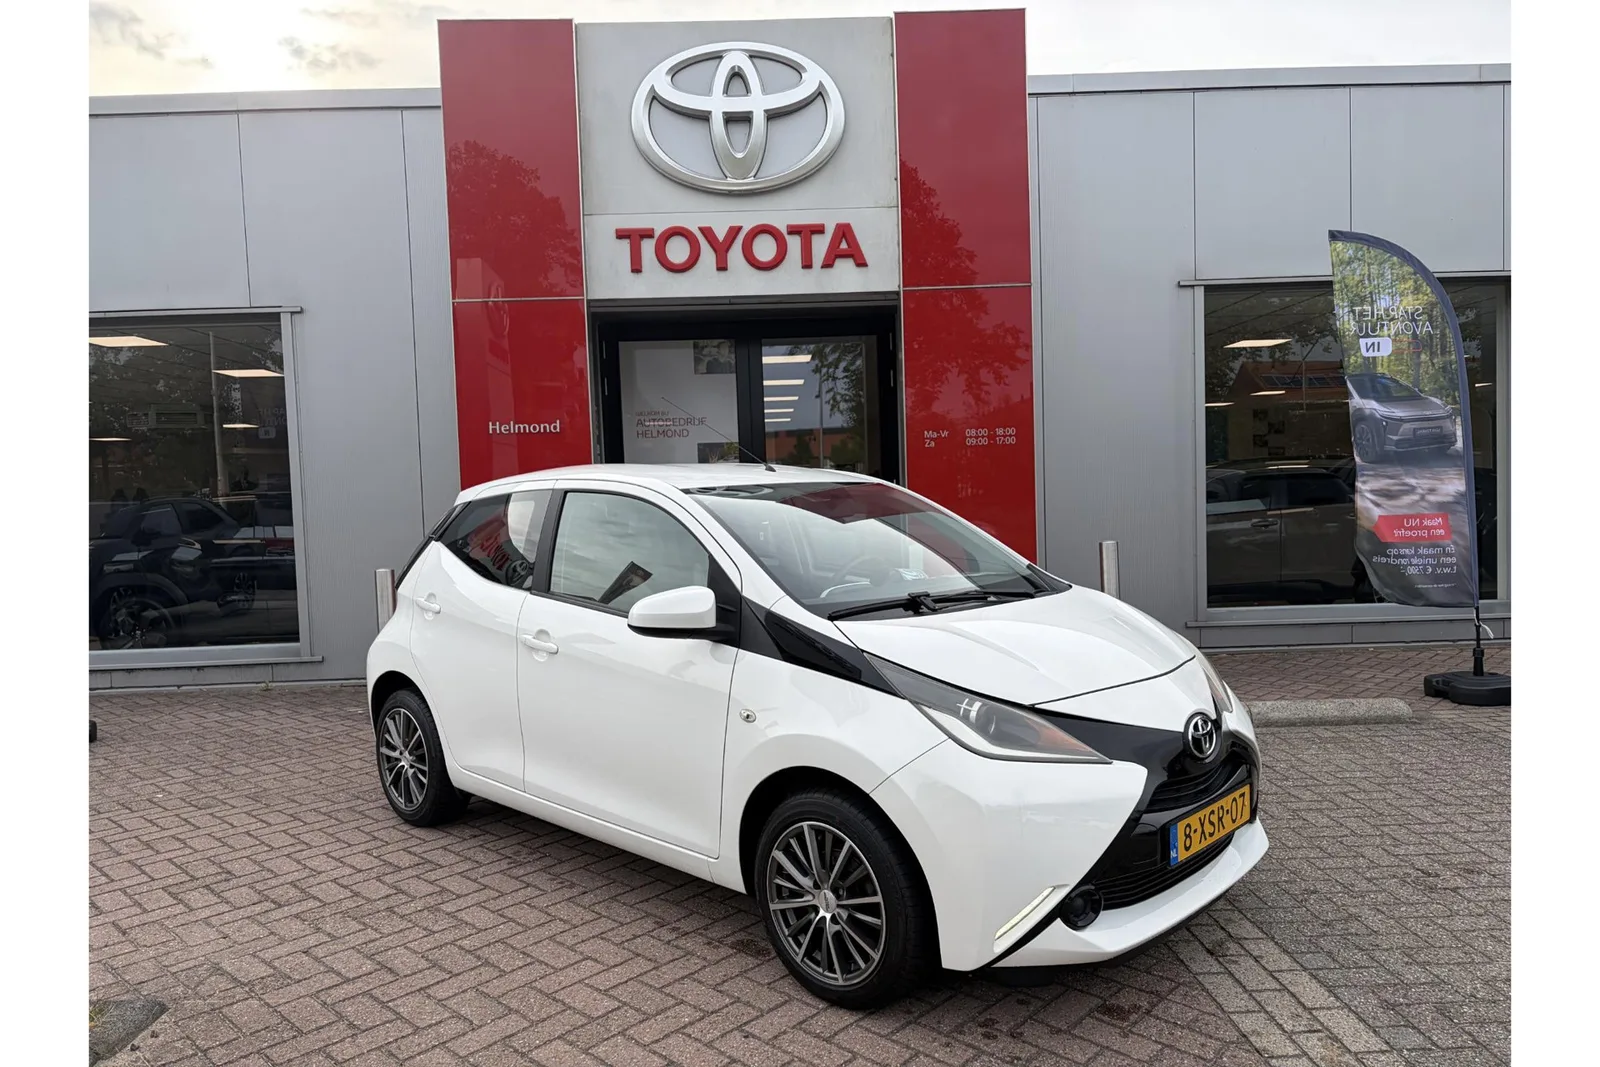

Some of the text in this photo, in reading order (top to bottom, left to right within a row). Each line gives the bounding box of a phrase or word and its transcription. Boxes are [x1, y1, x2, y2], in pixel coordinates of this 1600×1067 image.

[615, 222, 869, 273] TOYOTA
[488, 419, 560, 434] Helmond
[636, 428, 690, 439] HELMOND
[924, 429, 949, 439] Ma-Vr
[965, 428, 988, 437] 08:00
[995, 427, 1016, 436] 18:00
[924, 439, 935, 448] Za
[965, 437, 988, 446] 09:00
[995, 436, 1016, 444] 17:00
[1183, 791, 1246, 852] 8-XSR-07
[1170, 848, 1178, 859] NL
